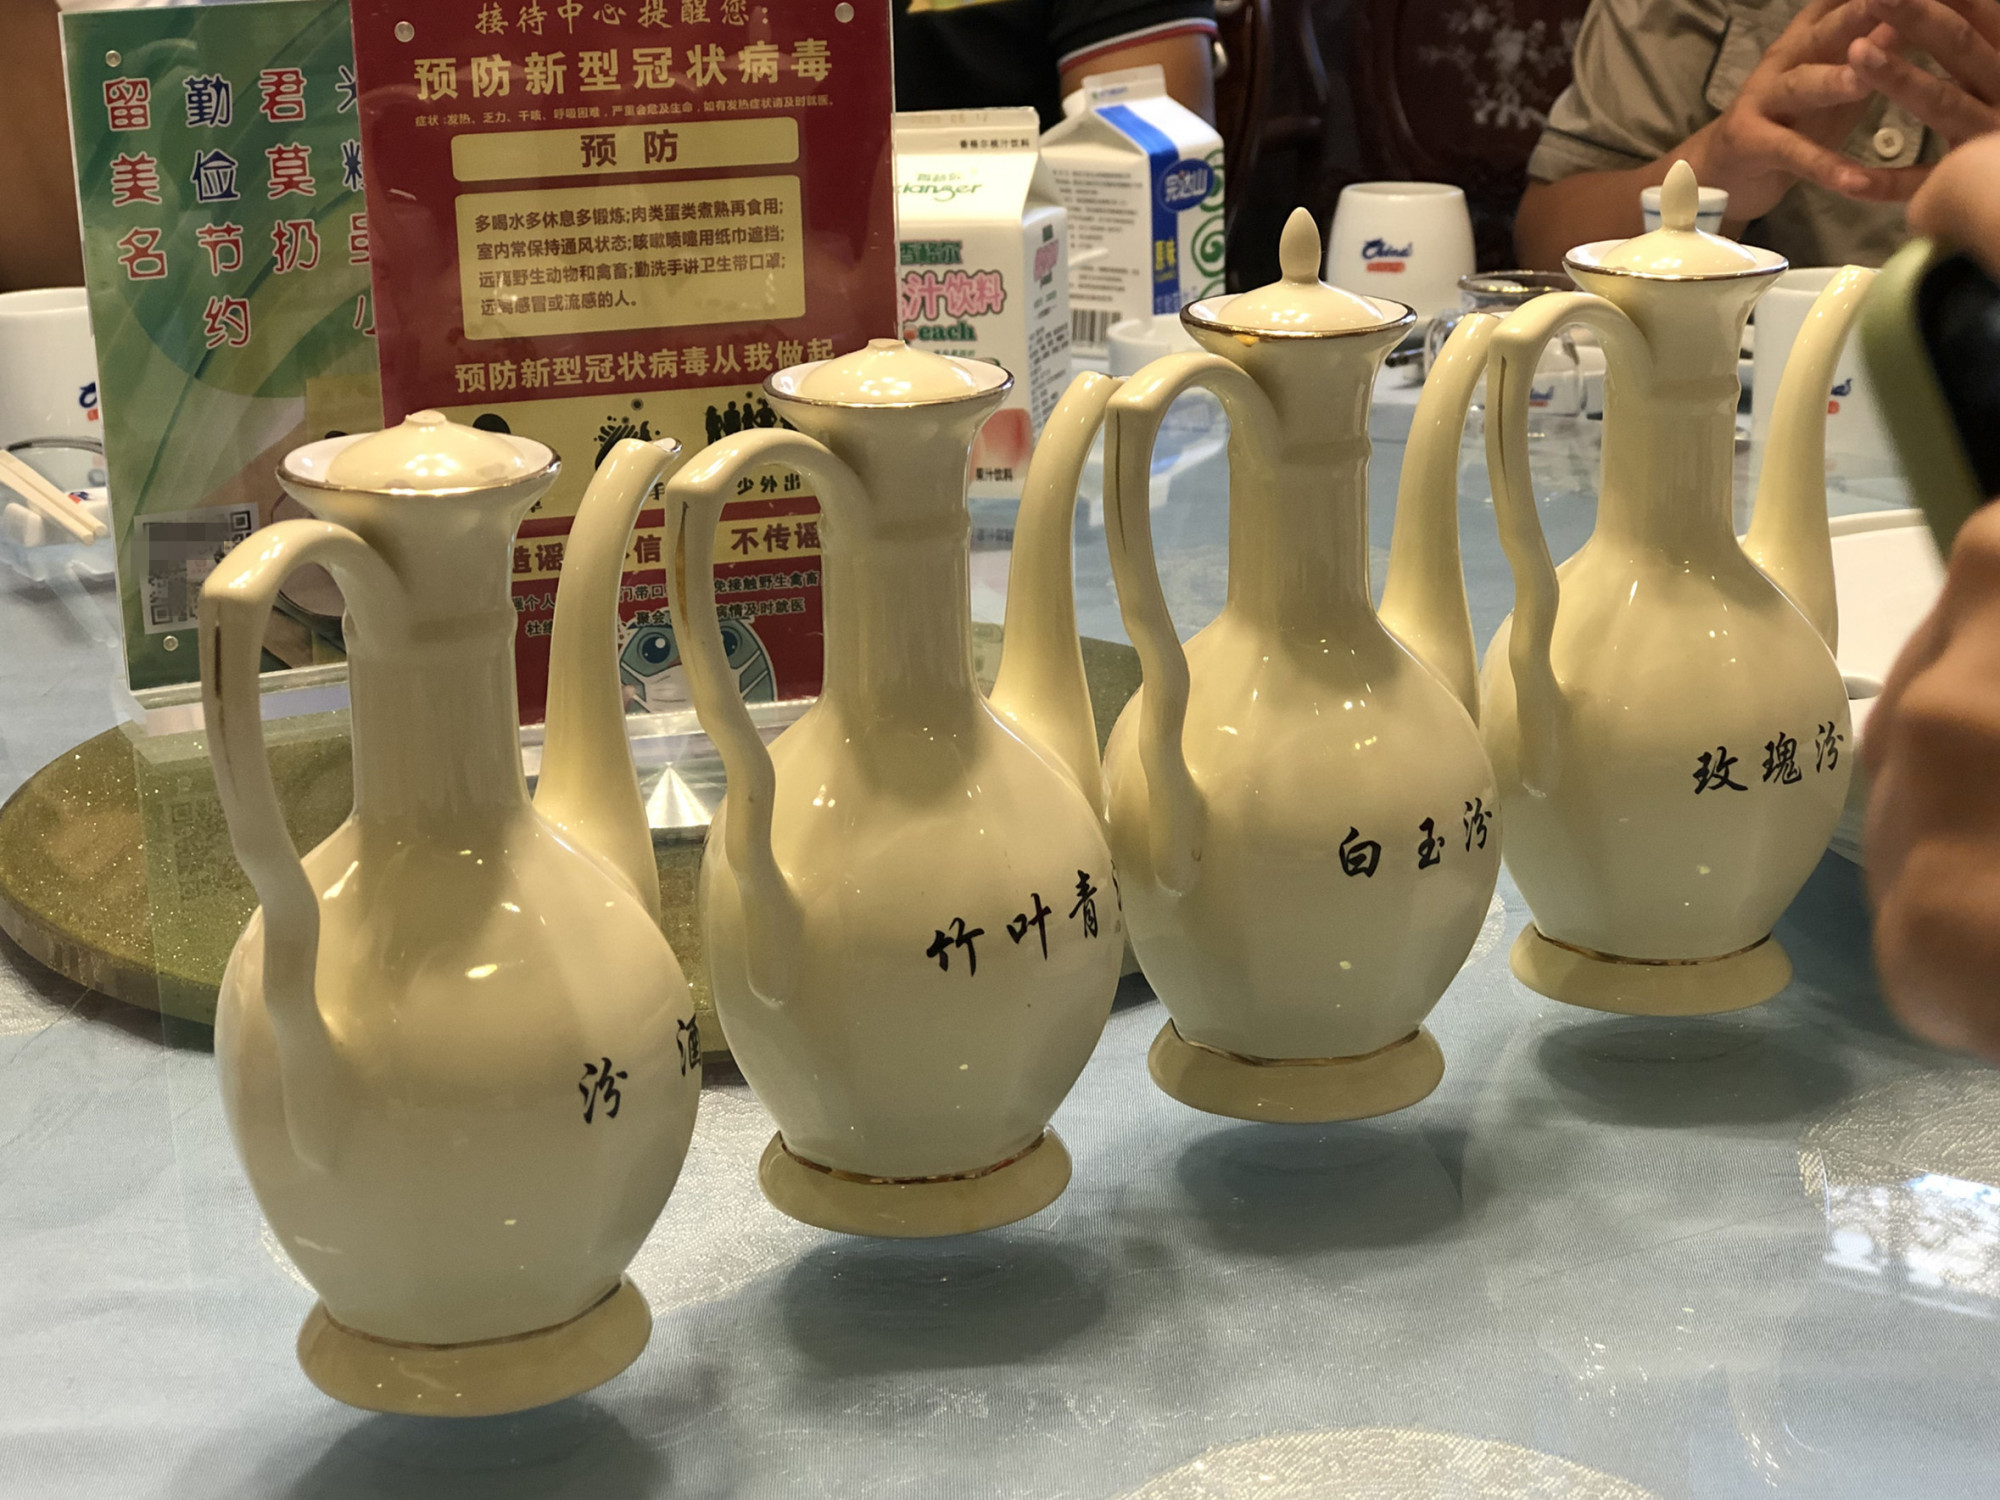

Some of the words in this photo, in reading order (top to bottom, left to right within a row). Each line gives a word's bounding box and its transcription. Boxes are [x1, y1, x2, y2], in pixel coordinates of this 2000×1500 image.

[414, 38, 833, 101] 预防新型冠状病毒
[103, 77, 167, 280] 留美名
[258, 68, 320, 273] 君莫扔
[580, 129, 678, 168] 预防
[183, 74, 250, 349] 勤俭节约
[900, 269, 1007, 323] 汁饮料
[455, 338, 835, 393] 预防新型冠状病毒从我做起
[625, 534, 662, 564] 信
[731, 521, 821, 555] 不传谣
[926, 859, 1122, 978] 竹叶青
